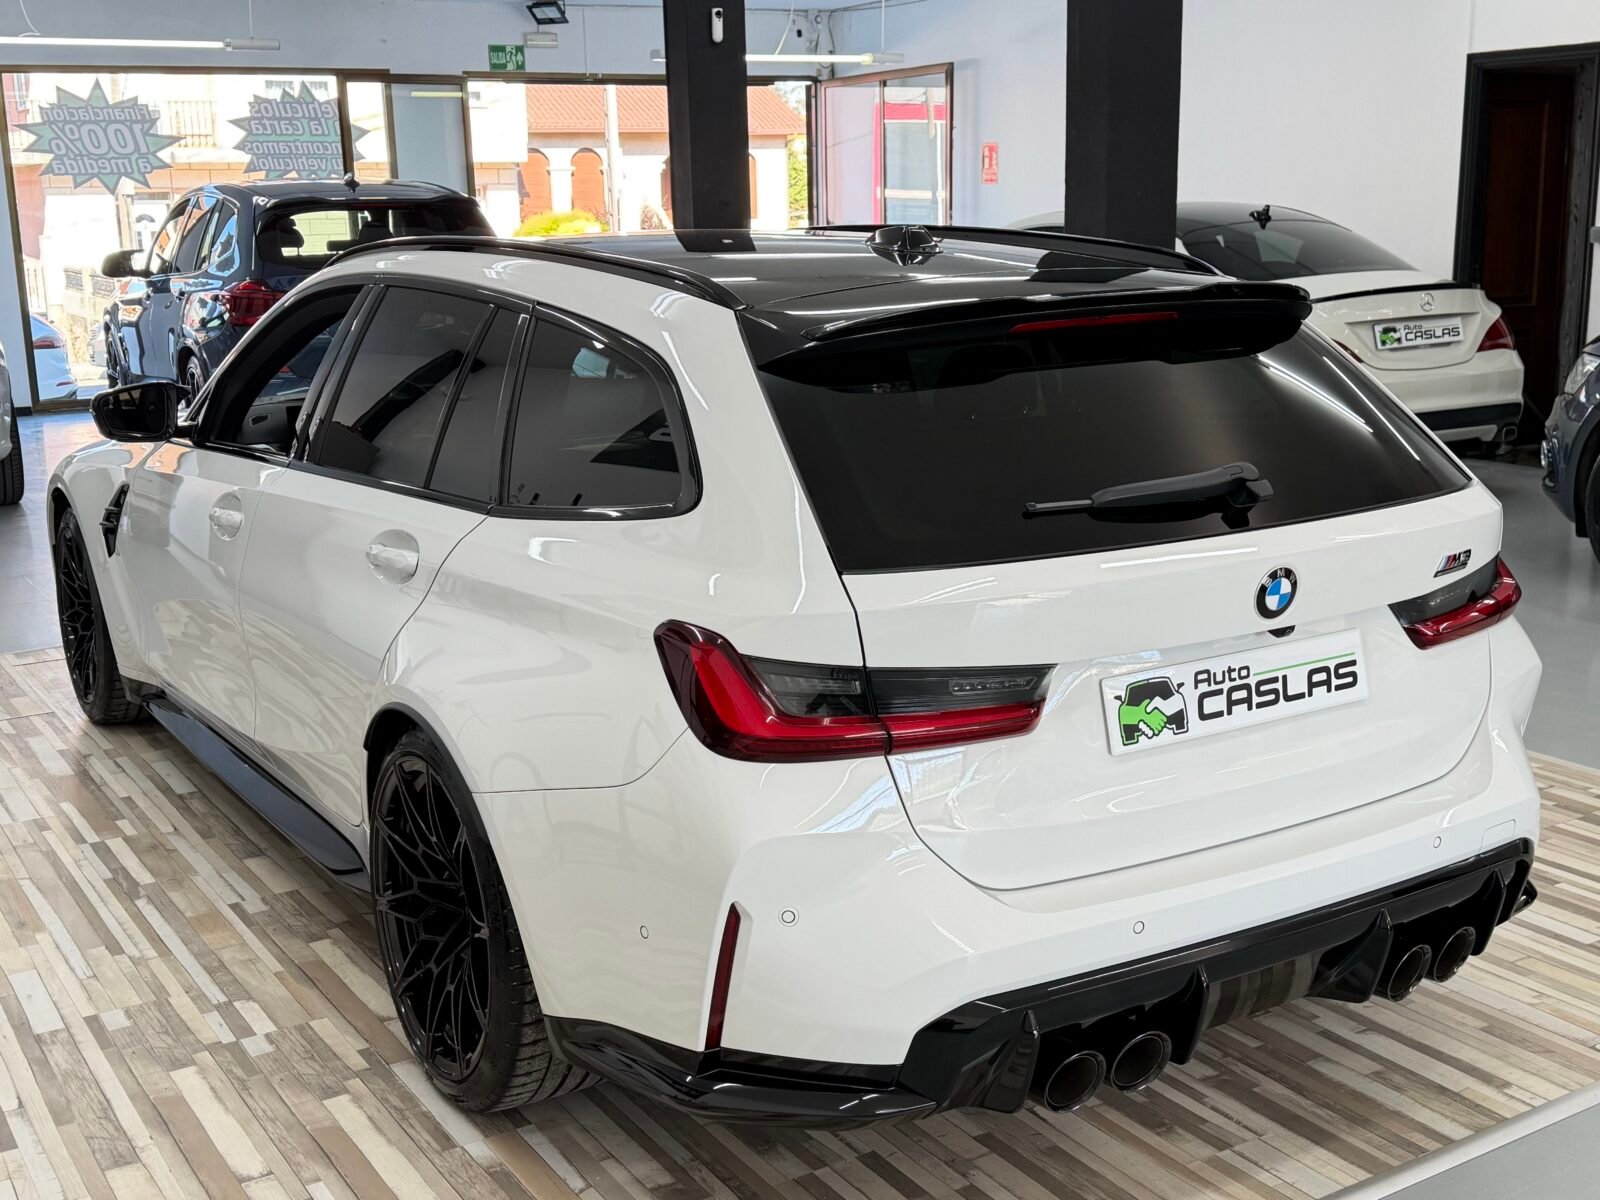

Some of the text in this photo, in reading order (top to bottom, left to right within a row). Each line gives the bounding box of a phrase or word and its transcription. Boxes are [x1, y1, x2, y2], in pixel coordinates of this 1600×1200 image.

[490, 52, 507, 64] SALIDA
[1404, 327, 1460, 342] CASLAS
[1193, 665, 1251, 690] Auto
[1197, 659, 1359, 722] CASLAS
